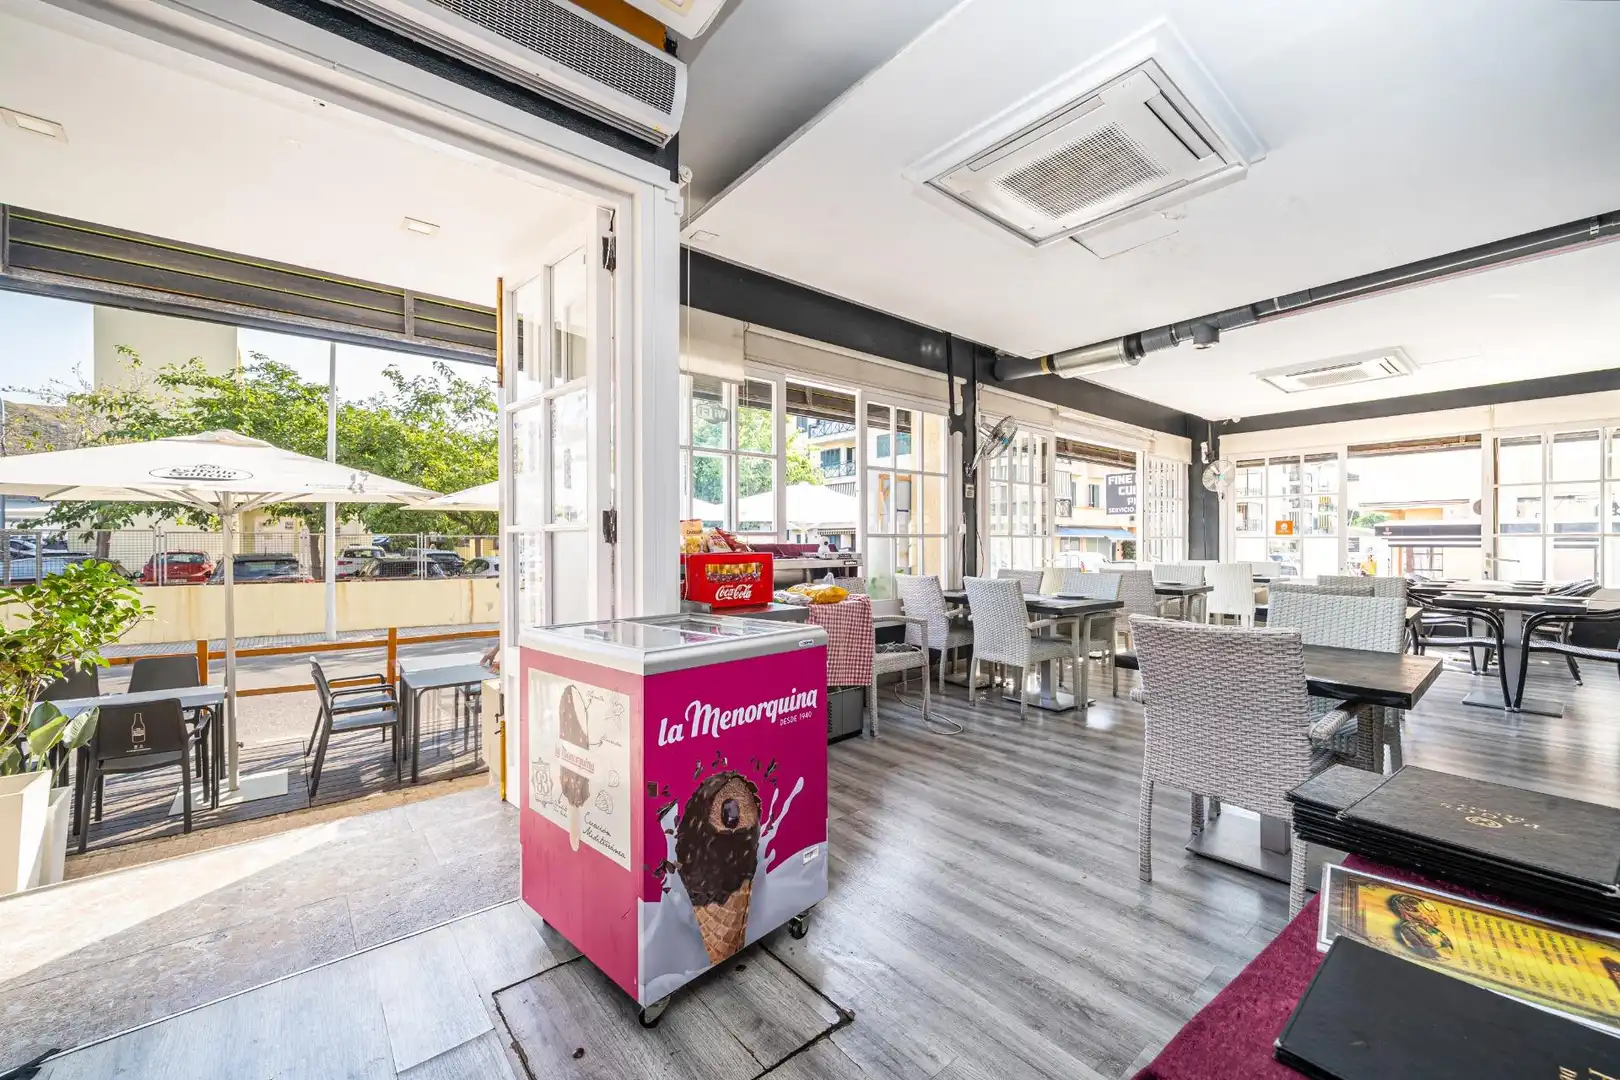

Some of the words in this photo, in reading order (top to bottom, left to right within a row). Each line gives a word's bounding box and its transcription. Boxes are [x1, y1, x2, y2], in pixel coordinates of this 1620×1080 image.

[1108, 475, 1133, 485] FINE
[1108, 506, 1134, 514] SERVICIO
[658, 717, 684, 747] la
[685, 687, 818, 738] Menorquina
[780, 715, 798, 727] DESDE
[799, 710, 813, 721] 1940
